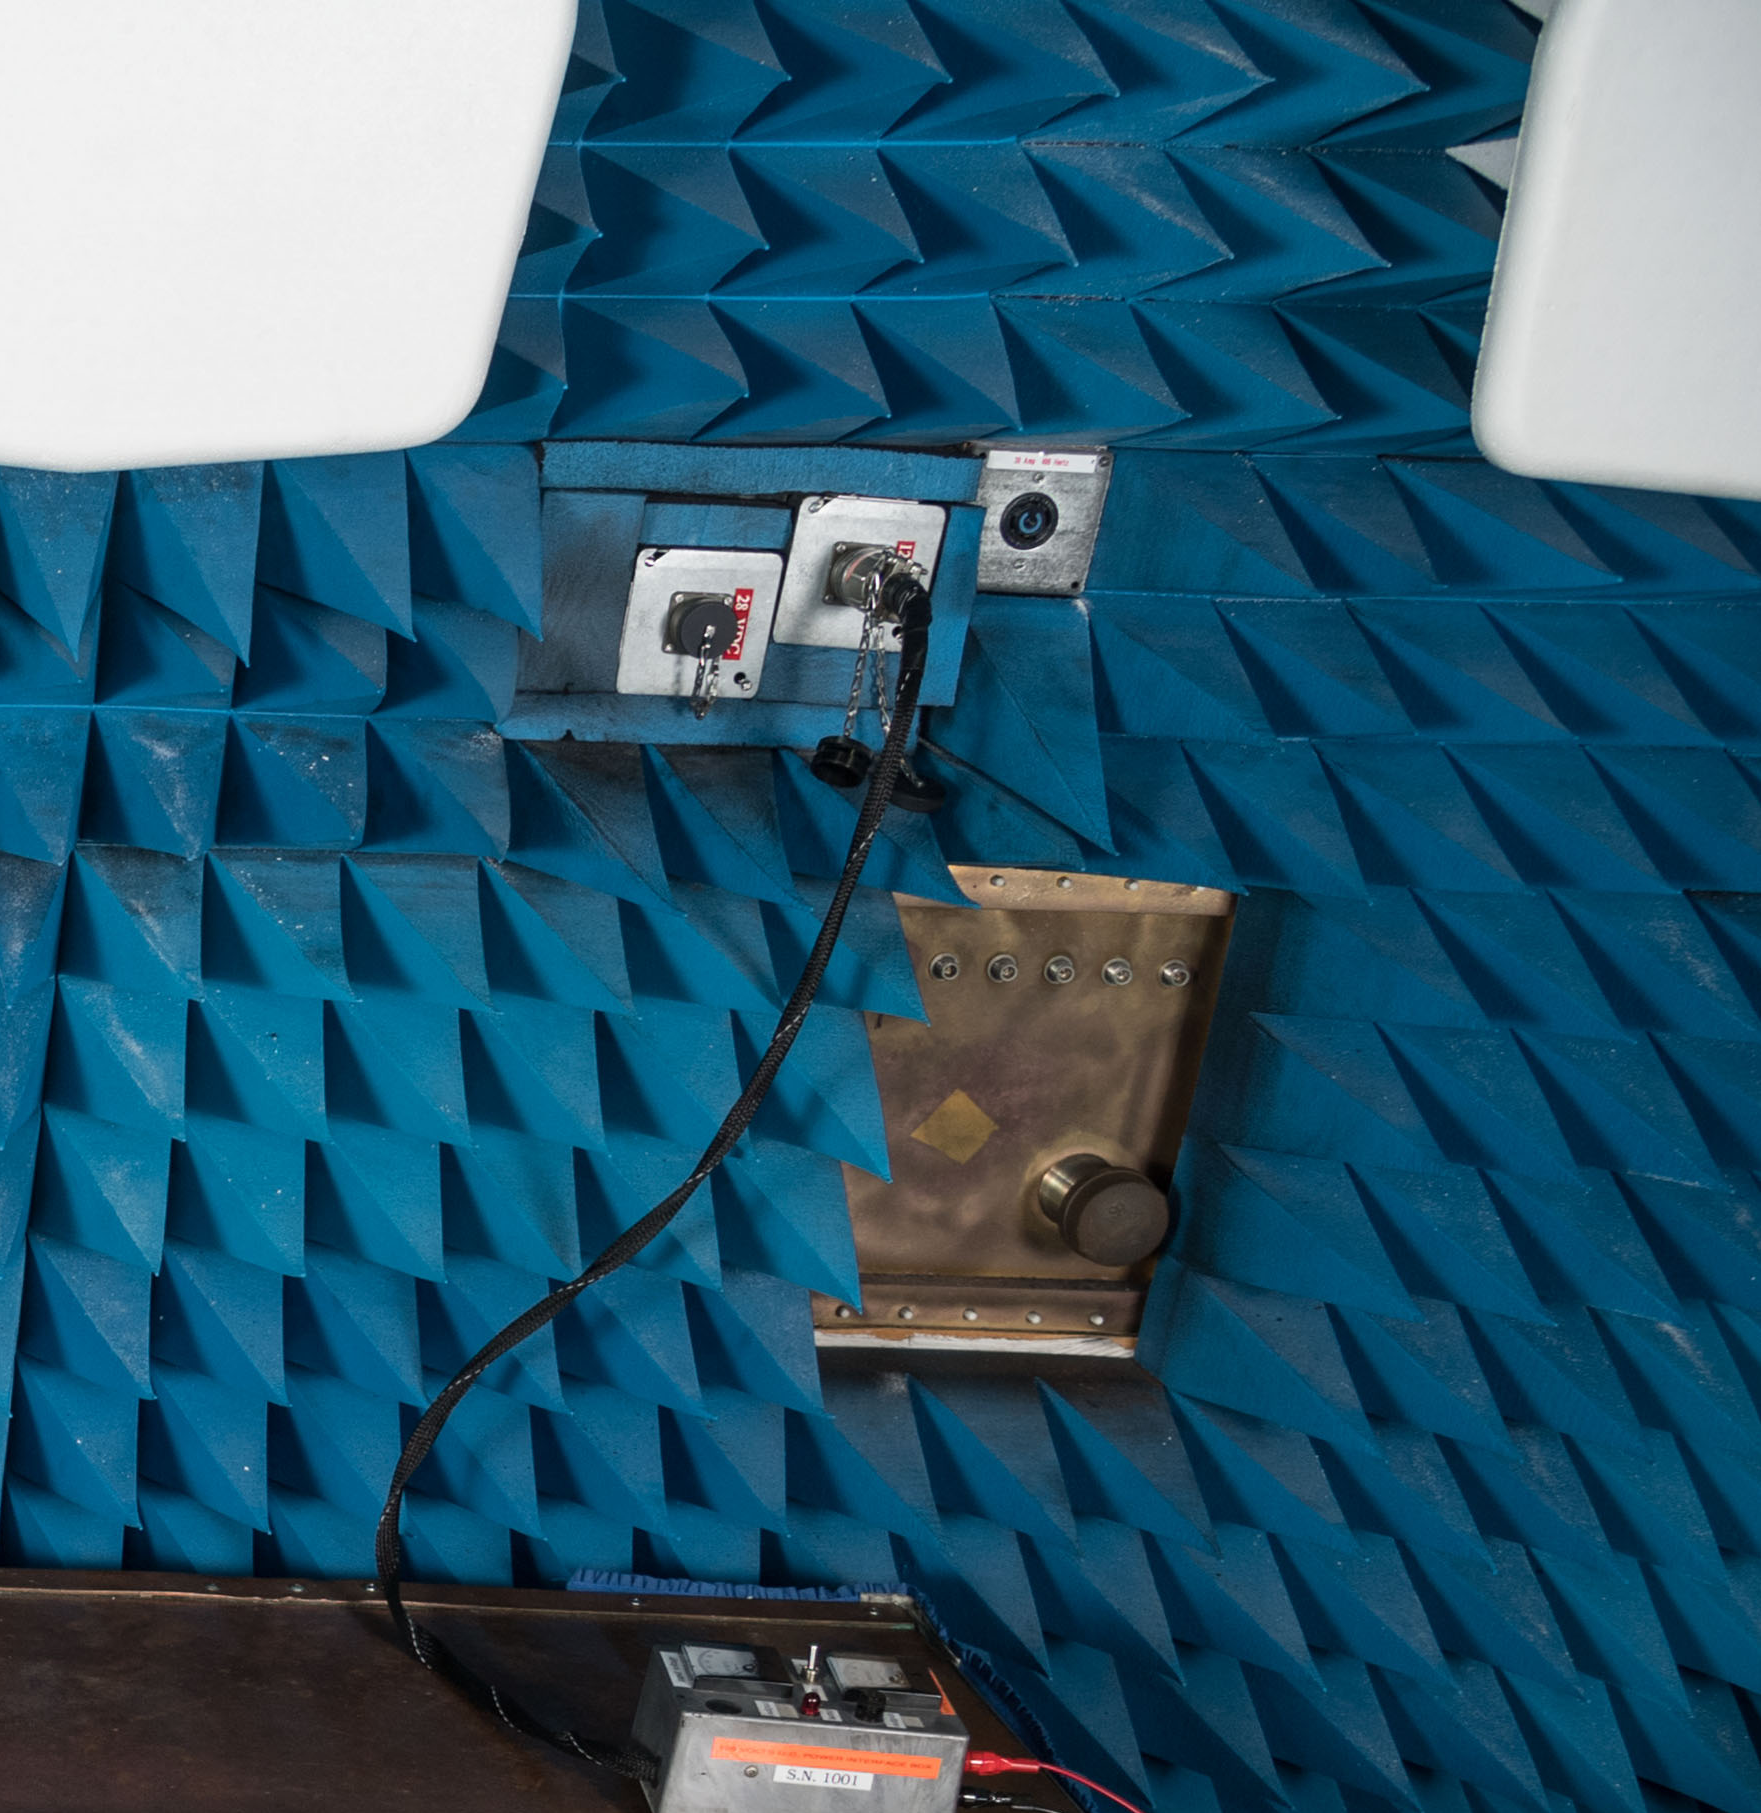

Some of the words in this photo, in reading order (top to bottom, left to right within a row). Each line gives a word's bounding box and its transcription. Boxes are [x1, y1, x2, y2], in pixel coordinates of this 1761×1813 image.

[735, 594, 751, 612] 28
[803, 1751, 844, 1763] POWER
[846, 1755, 907, 1768] INTERFACE
[909, 1760, 933, 1770] BOX
[786, 1769, 816, 1783] S.N.
[823, 1772, 859, 1787] 1001
